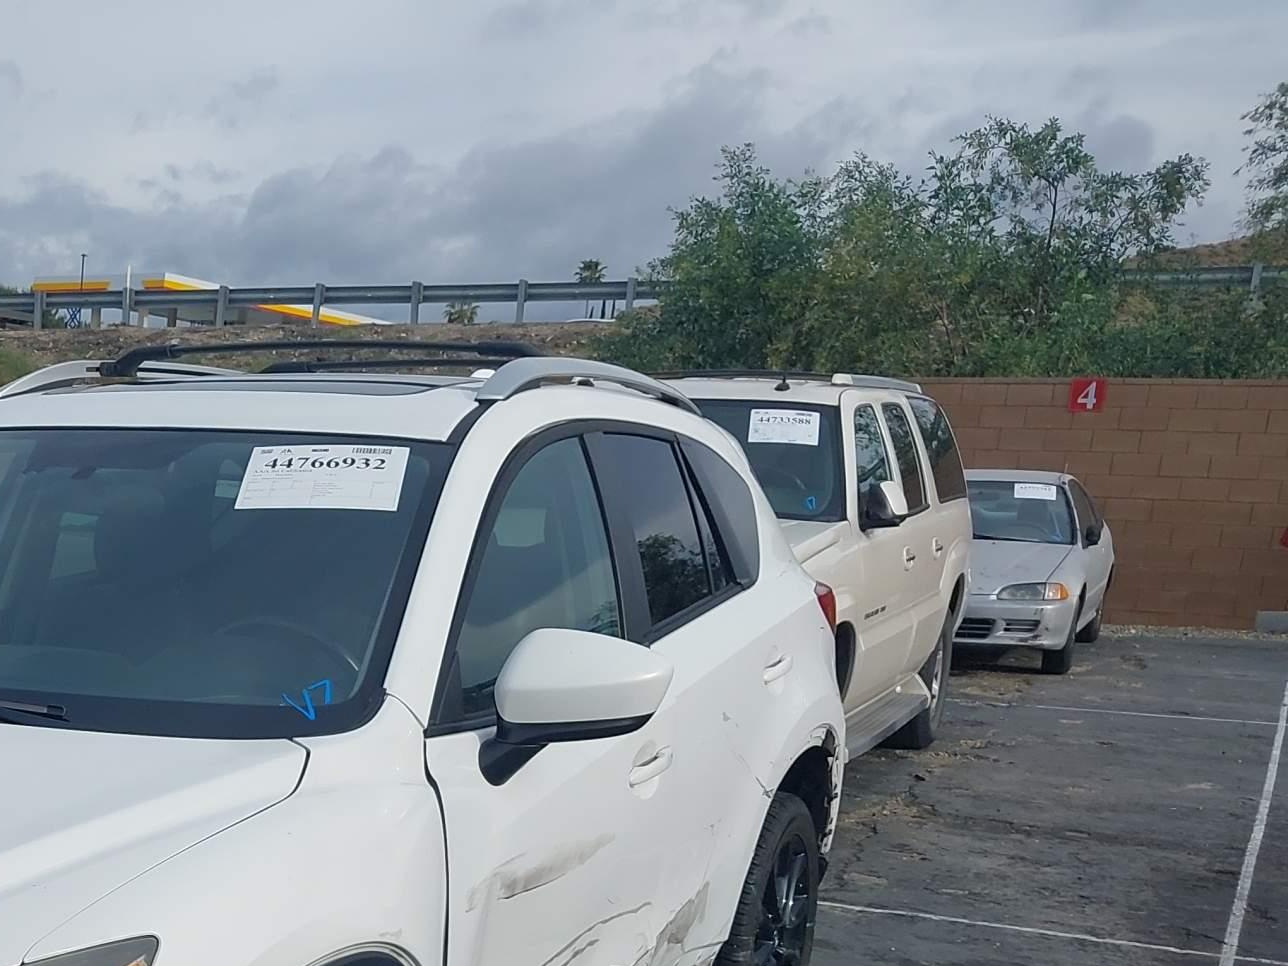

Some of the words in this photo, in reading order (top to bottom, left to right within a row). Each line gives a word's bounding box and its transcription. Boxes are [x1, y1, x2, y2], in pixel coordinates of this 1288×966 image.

[1077, 380, 1097, 409] 4
[757, 416, 811, 425] 44733588
[264, 457, 386, 470] 44766932
